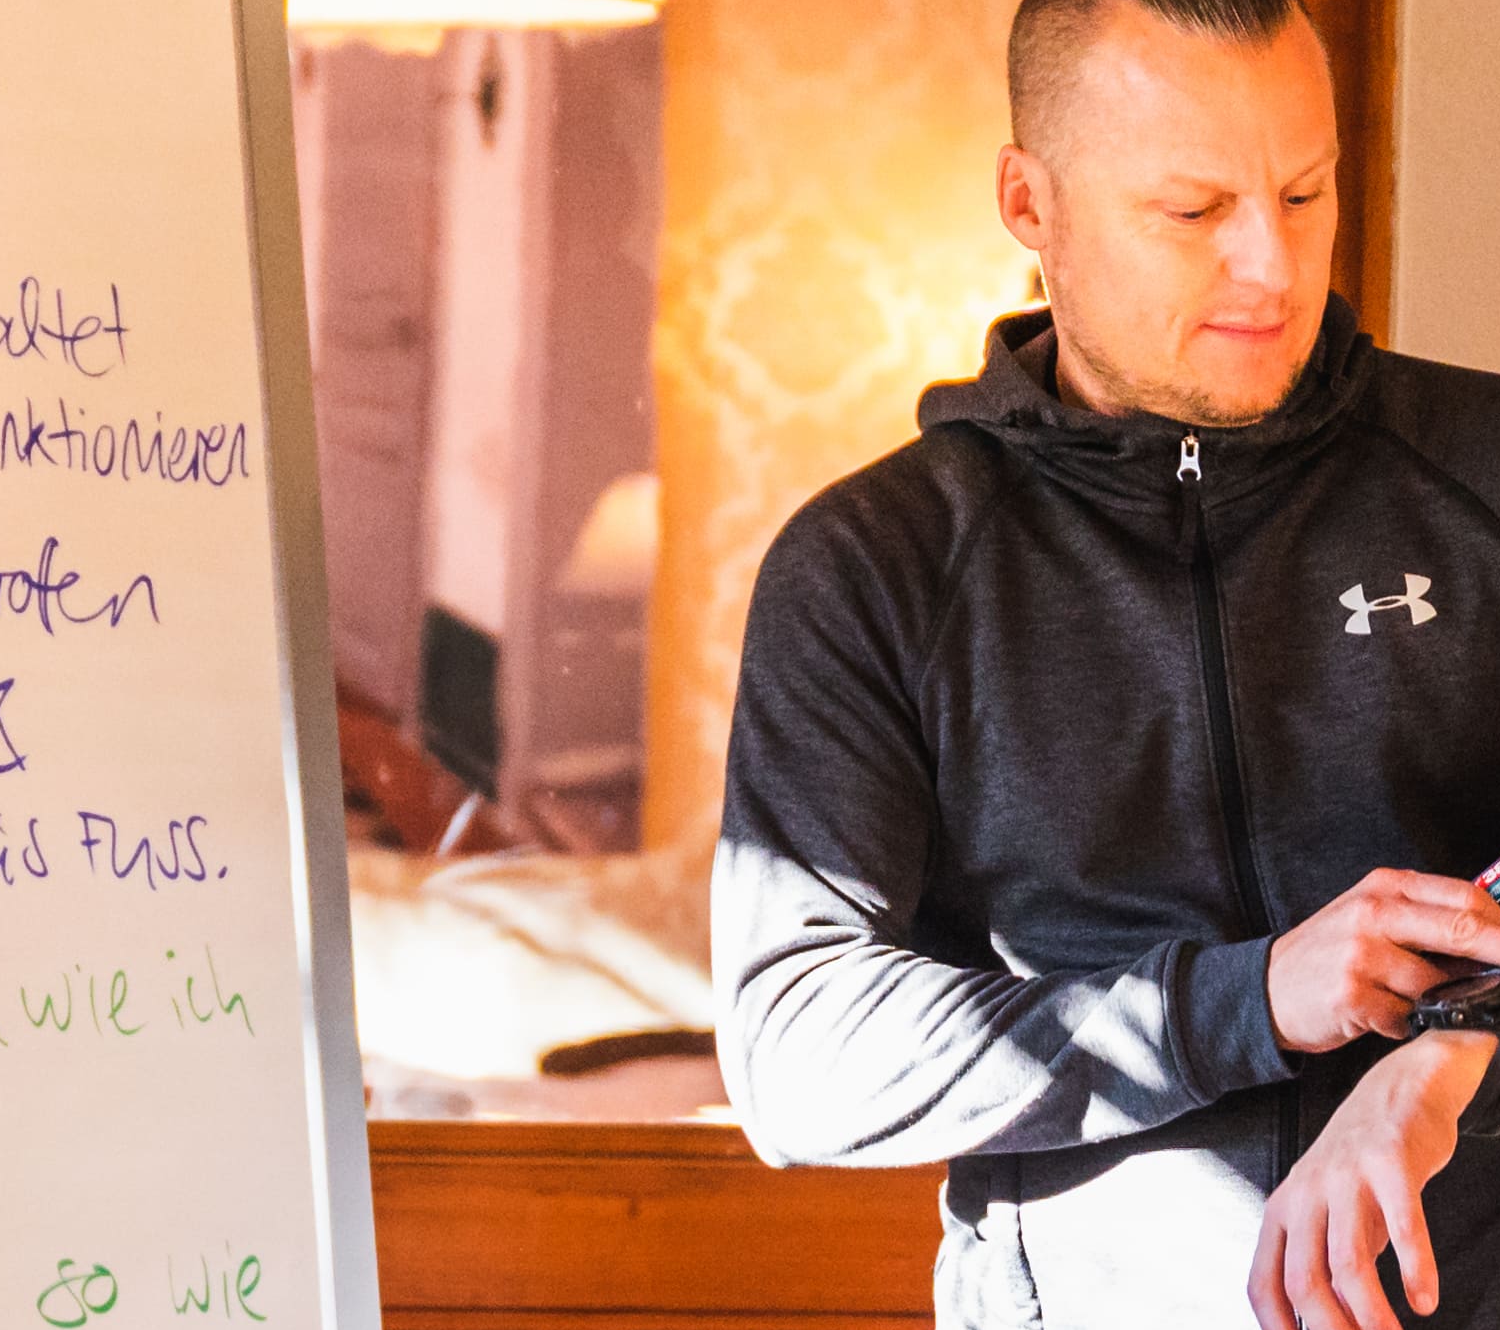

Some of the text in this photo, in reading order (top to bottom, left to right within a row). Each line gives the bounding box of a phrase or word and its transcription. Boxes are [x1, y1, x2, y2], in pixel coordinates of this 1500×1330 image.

[77, 811, 227, 890] Fuss.
[20, 963, 147, 1037] wie
[165, 943, 256, 1039] ich
[37, 1259, 118, 1329] so
[167, 1240, 267, 1322] wie
